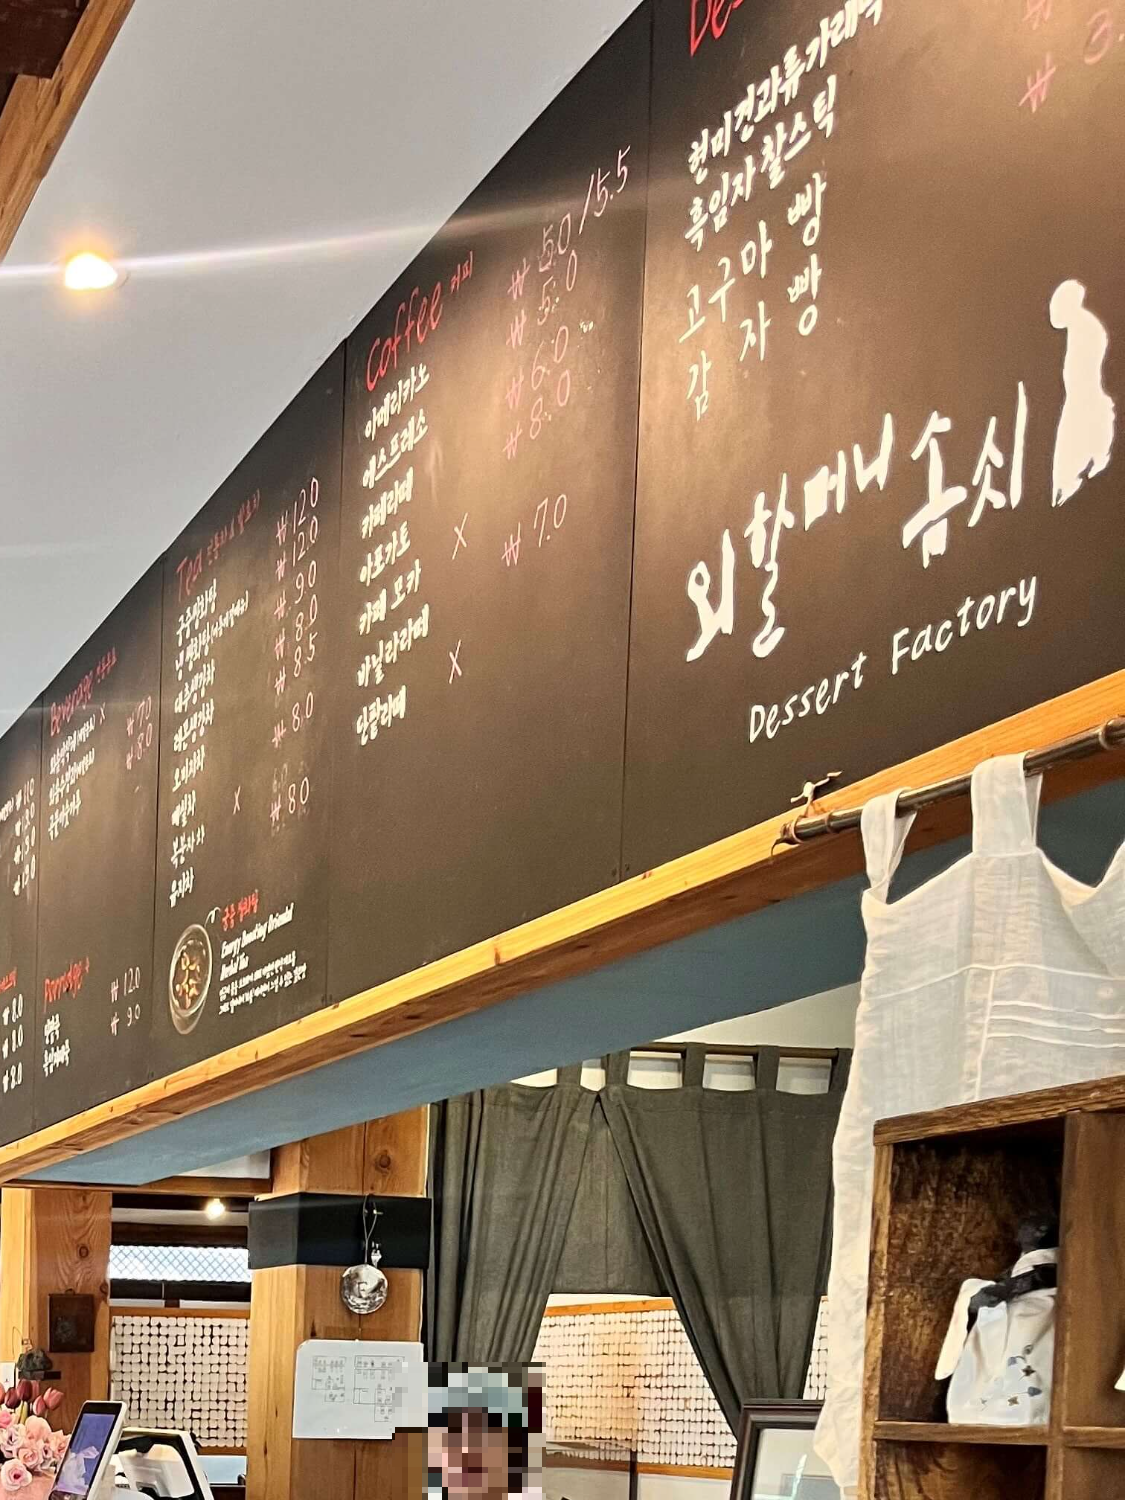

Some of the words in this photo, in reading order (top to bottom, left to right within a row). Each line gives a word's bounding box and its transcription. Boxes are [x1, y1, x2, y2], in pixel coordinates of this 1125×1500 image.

[366, 281, 443, 393] Coffee
[364, 362, 431, 442] 아메리카노
[361, 407, 430, 490] 에스프레소
[359, 520, 412, 588] 아포가토
[356, 602, 431, 688] 바닐라라떼
[748, 651, 868, 745] Dessert
[890, 575, 1038, 676] Factory
